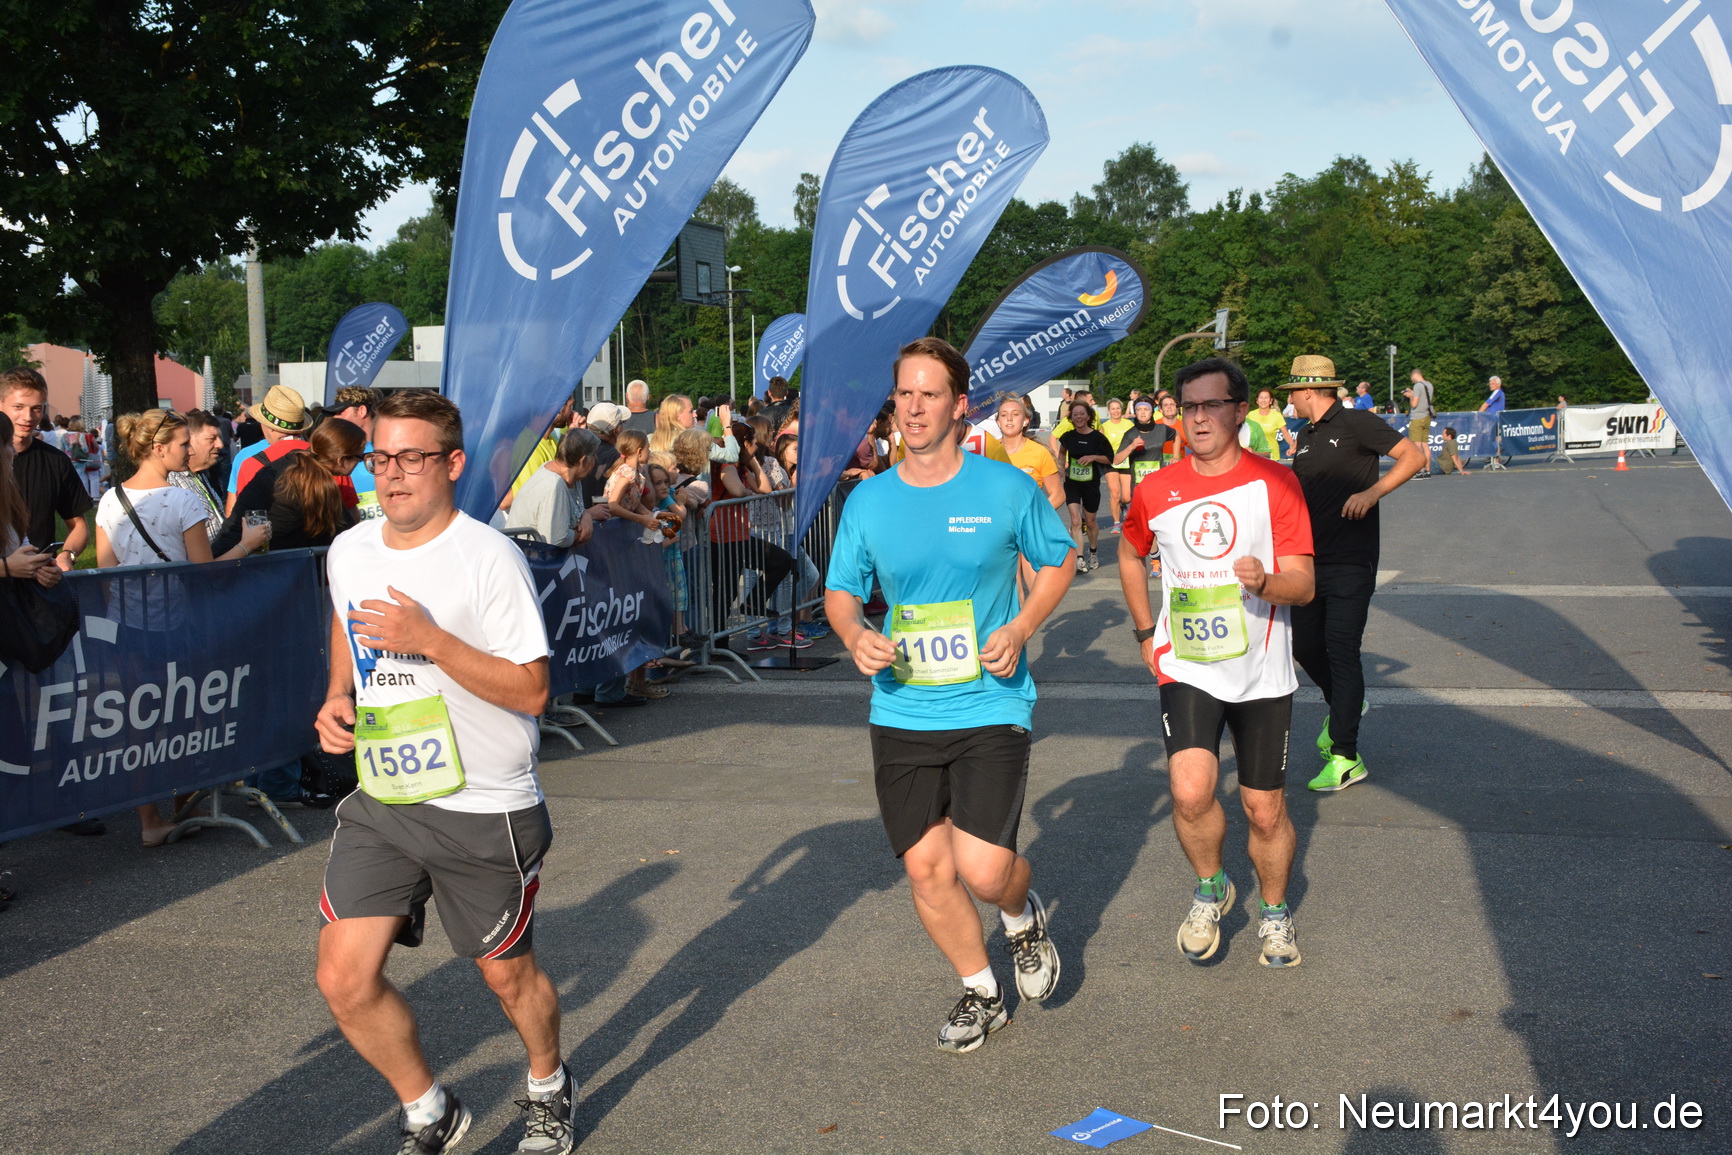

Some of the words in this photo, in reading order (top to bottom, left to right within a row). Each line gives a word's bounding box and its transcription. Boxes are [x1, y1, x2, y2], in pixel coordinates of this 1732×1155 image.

[612, 29, 759, 236] AUTOMOBILE
[867, 106, 997, 290] Fischer
[914, 139, 1011, 286] AUTOMOBILE
[345, 315, 391, 376] Fischer
[1045, 331, 1077, 357] Druck
[1078, 321, 1099, 338] und
[1098, 298, 1137, 328] Medien
[361, 326, 396, 375] AUTOMOBILE
[770, 323, 805, 373] Fischer
[1427, 433, 1477, 444] scer
[1502, 422, 1544, 438] Frischmann
[1606, 414, 1649, 437] swn
[1072, 466, 1091, 476] 1228
[948, 525, 976, 533] Michael
[956, 516, 992, 524] PFLEIDERER
[1209, 569, 1228, 579] MIT
[554, 587, 645, 641] Fischer
[1182, 615, 1229, 641] 536
[565, 628, 633, 666] AUTOMOBILE
[897, 633, 969, 663] 1106
[365, 668, 416, 687] Team
[33, 661, 250, 751] Fischer
[58, 721, 237, 788] AUTOMOBILE
[363, 737, 447, 778] 1582
